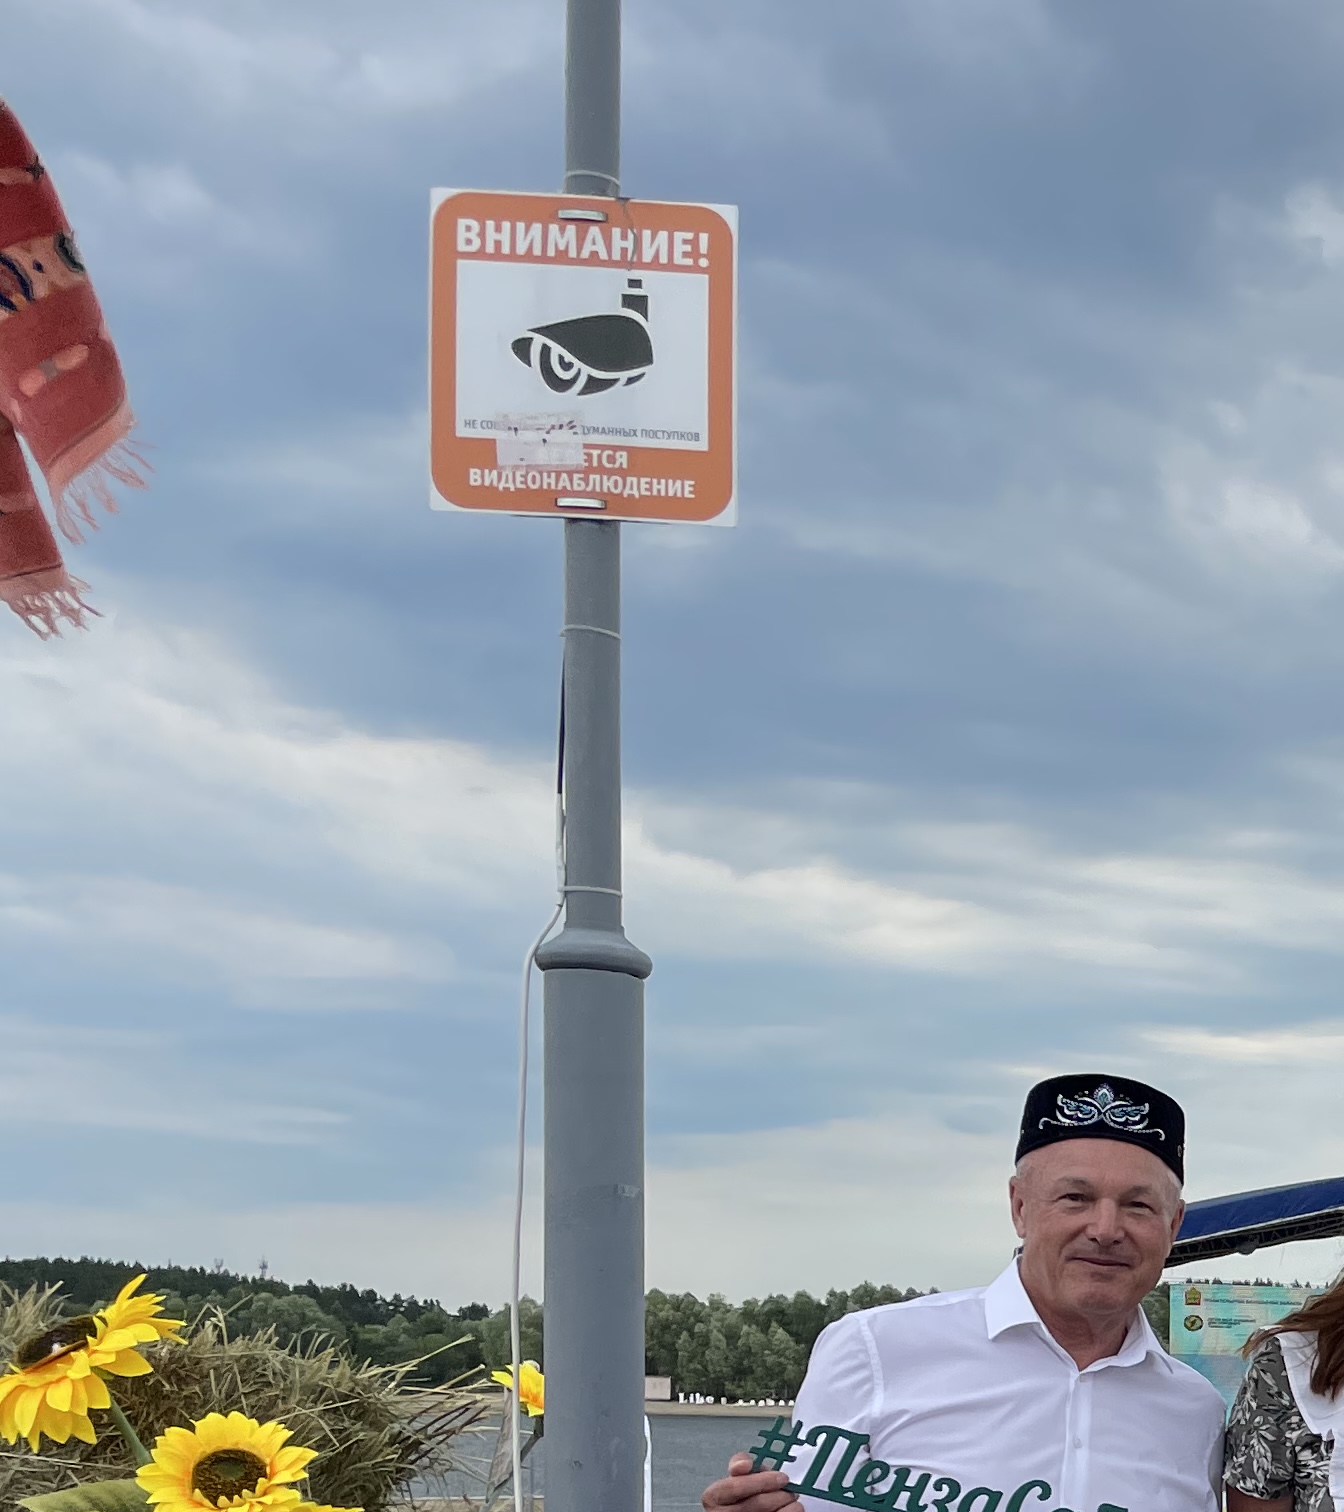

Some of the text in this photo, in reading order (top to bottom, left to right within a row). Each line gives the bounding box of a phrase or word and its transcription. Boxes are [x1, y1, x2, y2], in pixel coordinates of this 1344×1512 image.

[456, 218, 710, 268] ВНИМАНИЕ!
[464, 419, 478, 429] НЕ
[641, 429, 700, 442] ПОСТУПКОВ
[469, 468, 696, 498] ВИДЕОНАБЛЮДЕНИЕ
